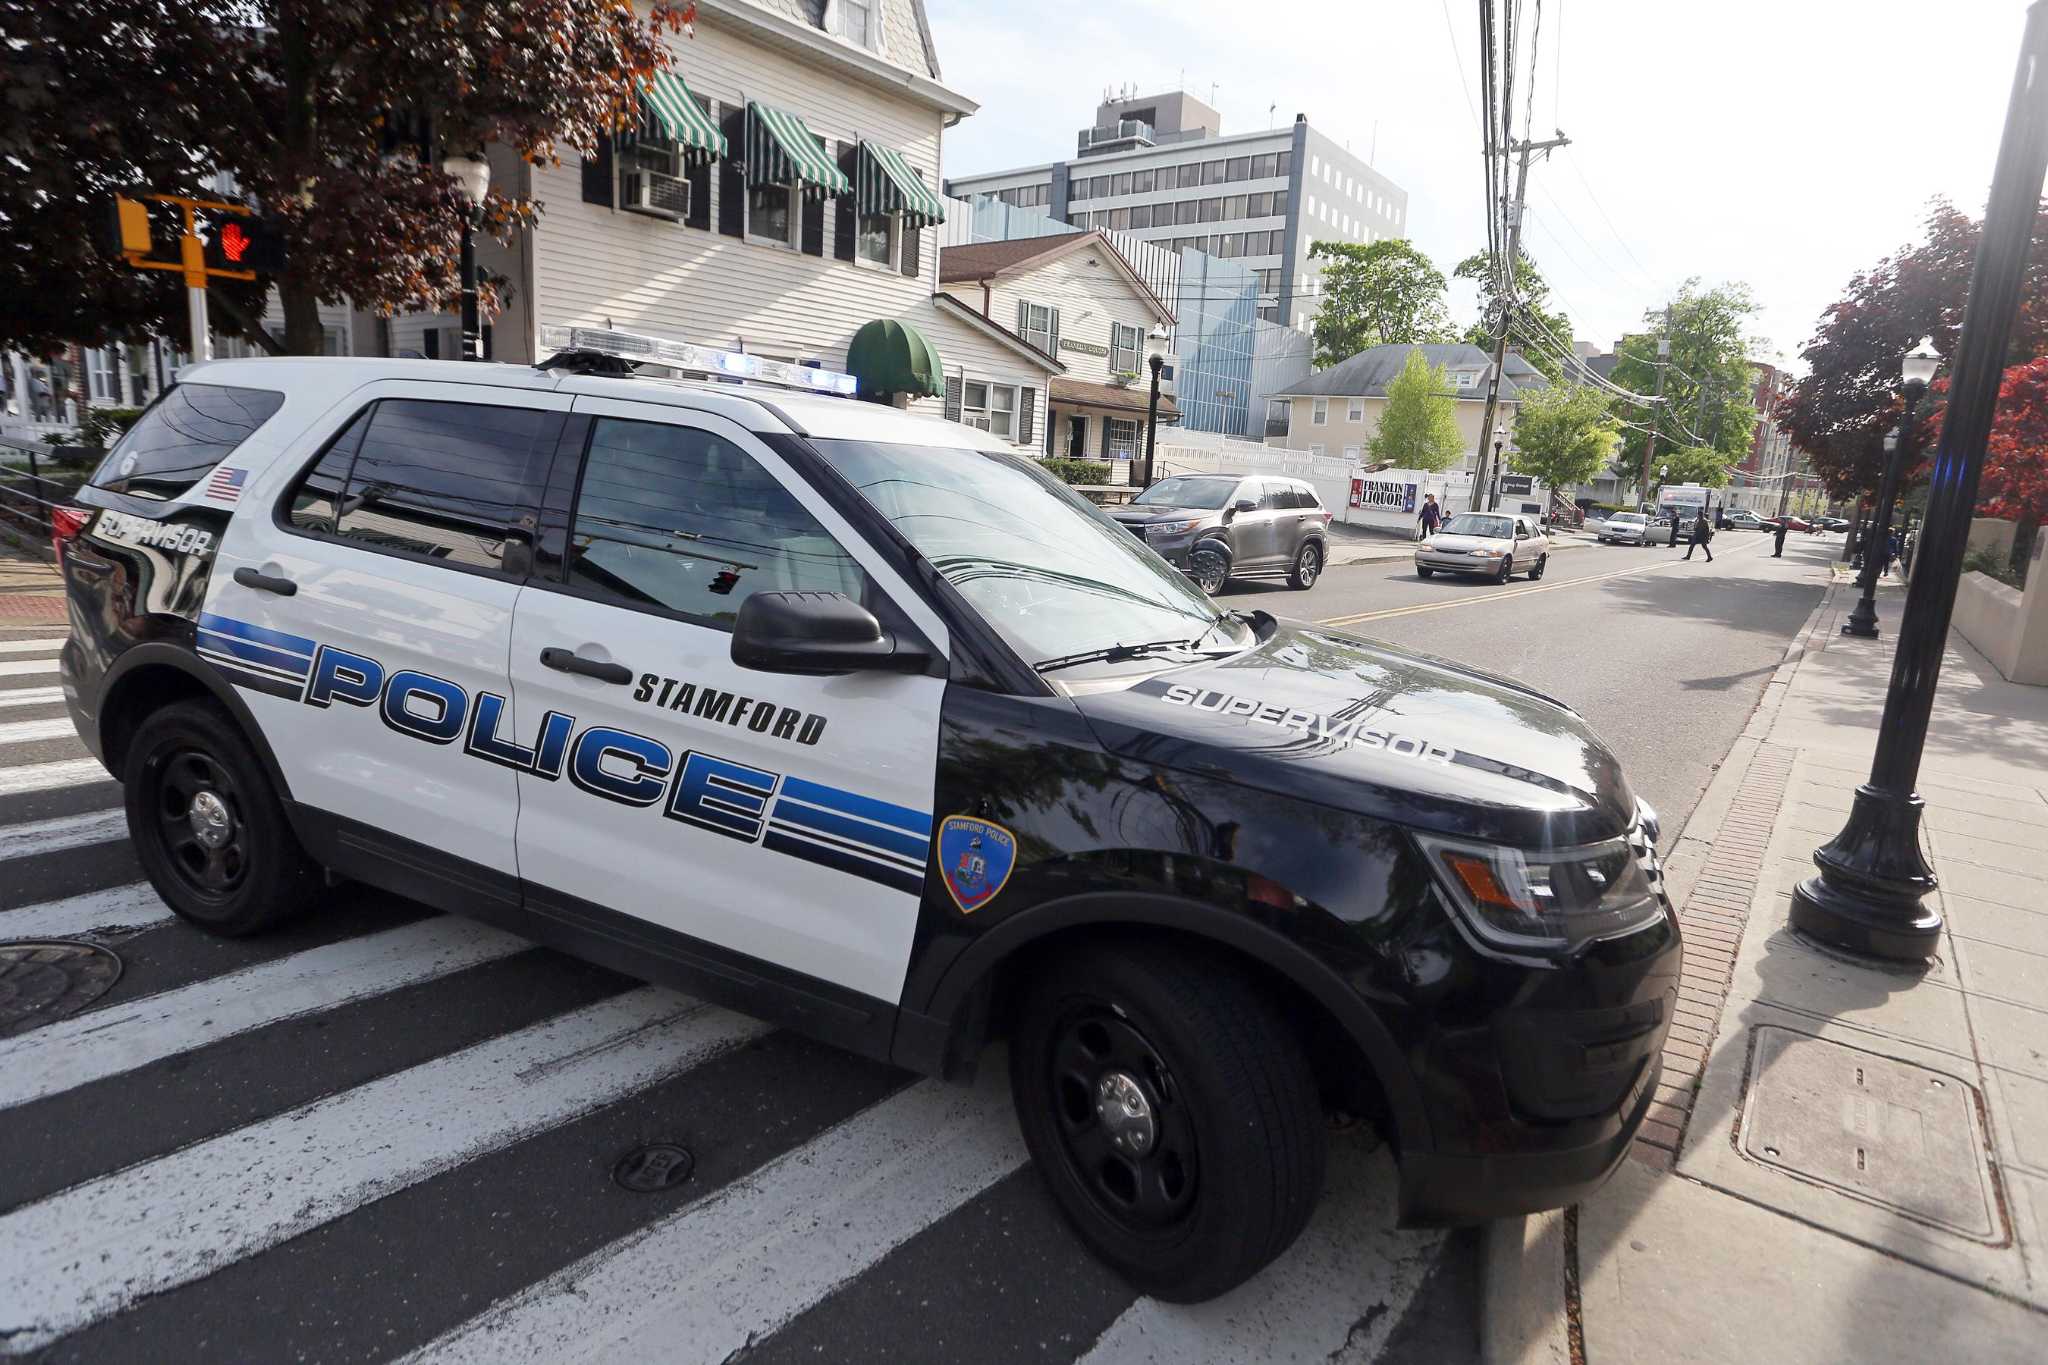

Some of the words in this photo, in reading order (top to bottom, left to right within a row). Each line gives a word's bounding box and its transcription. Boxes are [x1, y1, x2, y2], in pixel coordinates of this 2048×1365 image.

[1362, 491, 1402, 507] LIQUOR
[1364, 480, 1403, 493] FRANKLIN
[101, 516, 212, 556] SUPERVISOR
[632, 673, 828, 746] STAMFORD
[1161, 684, 1456, 767] SUPERVISOR
[305, 644, 779, 844] POLICE
[948, 821, 984, 834] STAMFORD
[985, 827, 1008, 847] POLICE
